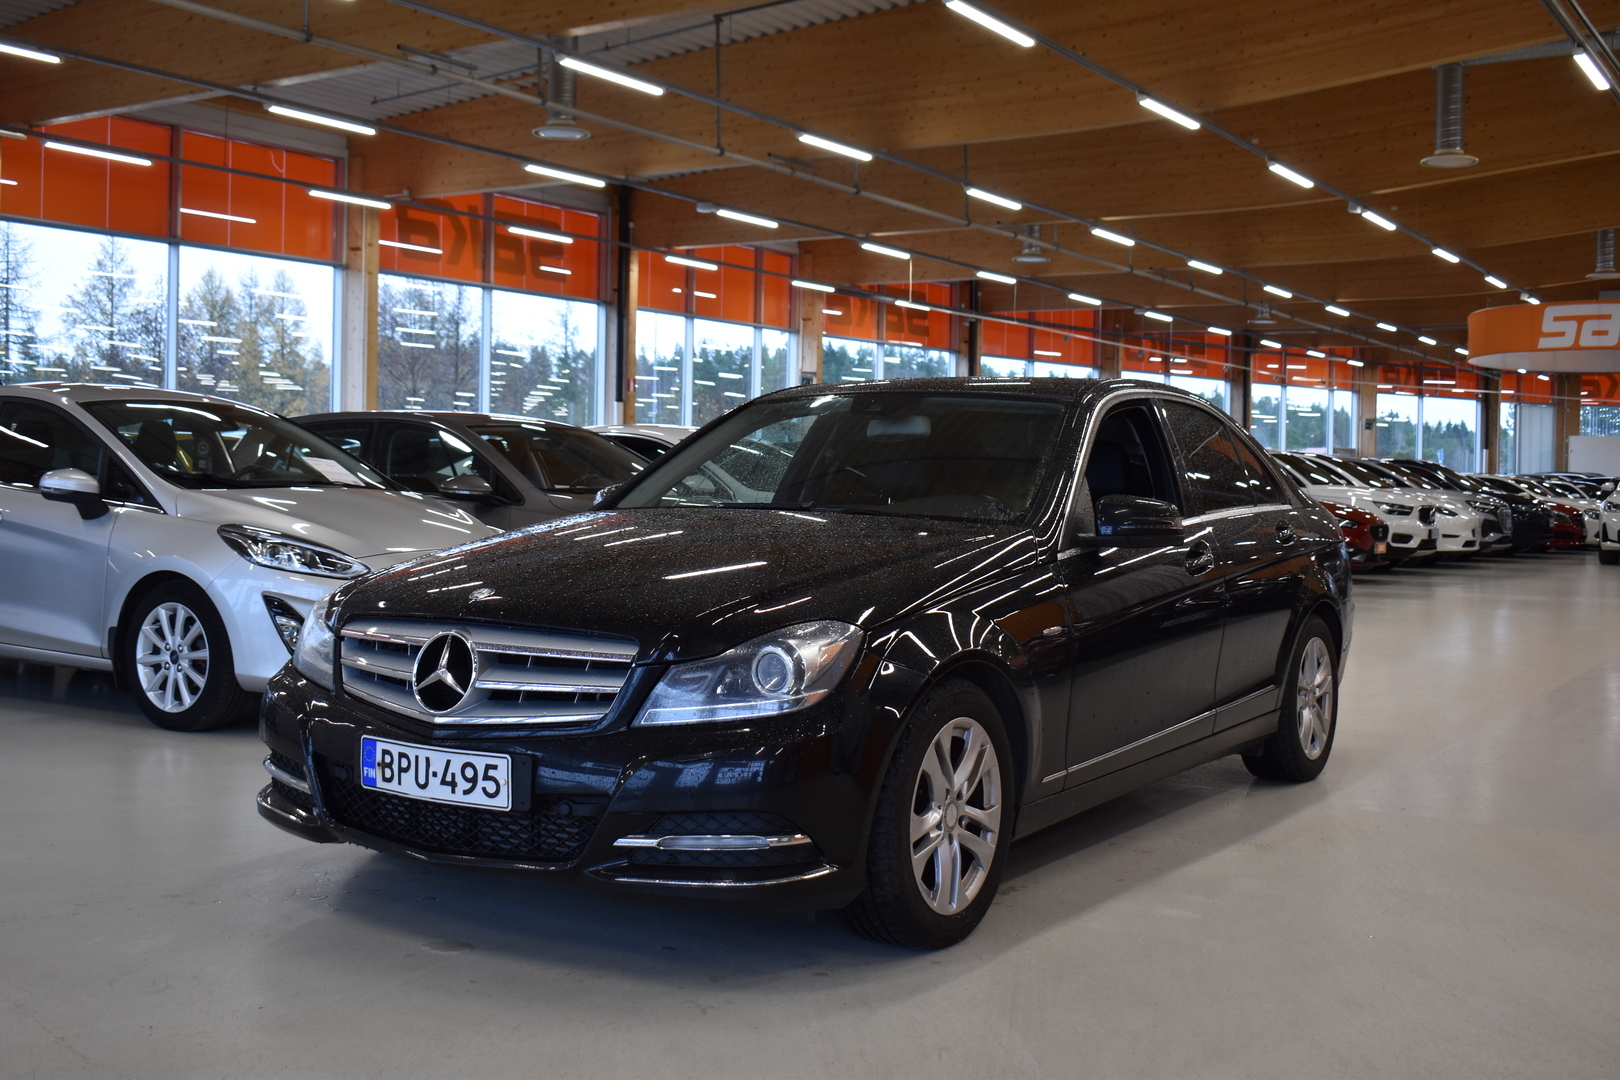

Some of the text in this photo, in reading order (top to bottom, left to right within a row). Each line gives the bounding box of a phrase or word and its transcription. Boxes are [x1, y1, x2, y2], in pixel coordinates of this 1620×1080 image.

[1538, 303, 1620, 349] sa
[364, 766, 376, 779] FIN
[381, 748, 501, 799] BPU-495
